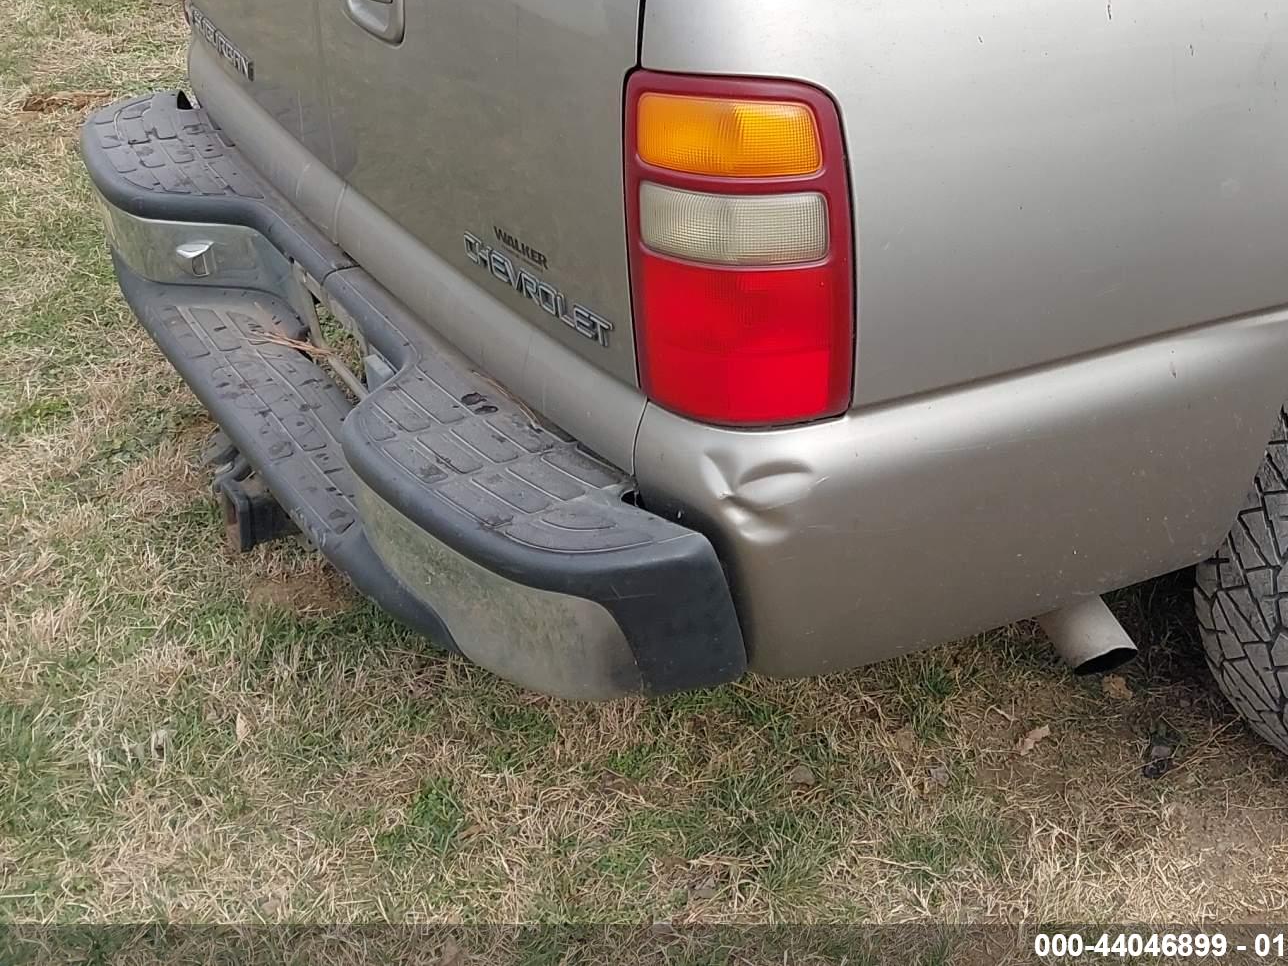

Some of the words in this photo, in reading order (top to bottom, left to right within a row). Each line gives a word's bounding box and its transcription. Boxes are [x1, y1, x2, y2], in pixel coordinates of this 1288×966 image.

[193, 8, 253, 81] SUBURBAN
[493, 225, 549, 270] WALKER
[463, 230, 614, 347] CHEVROLET
